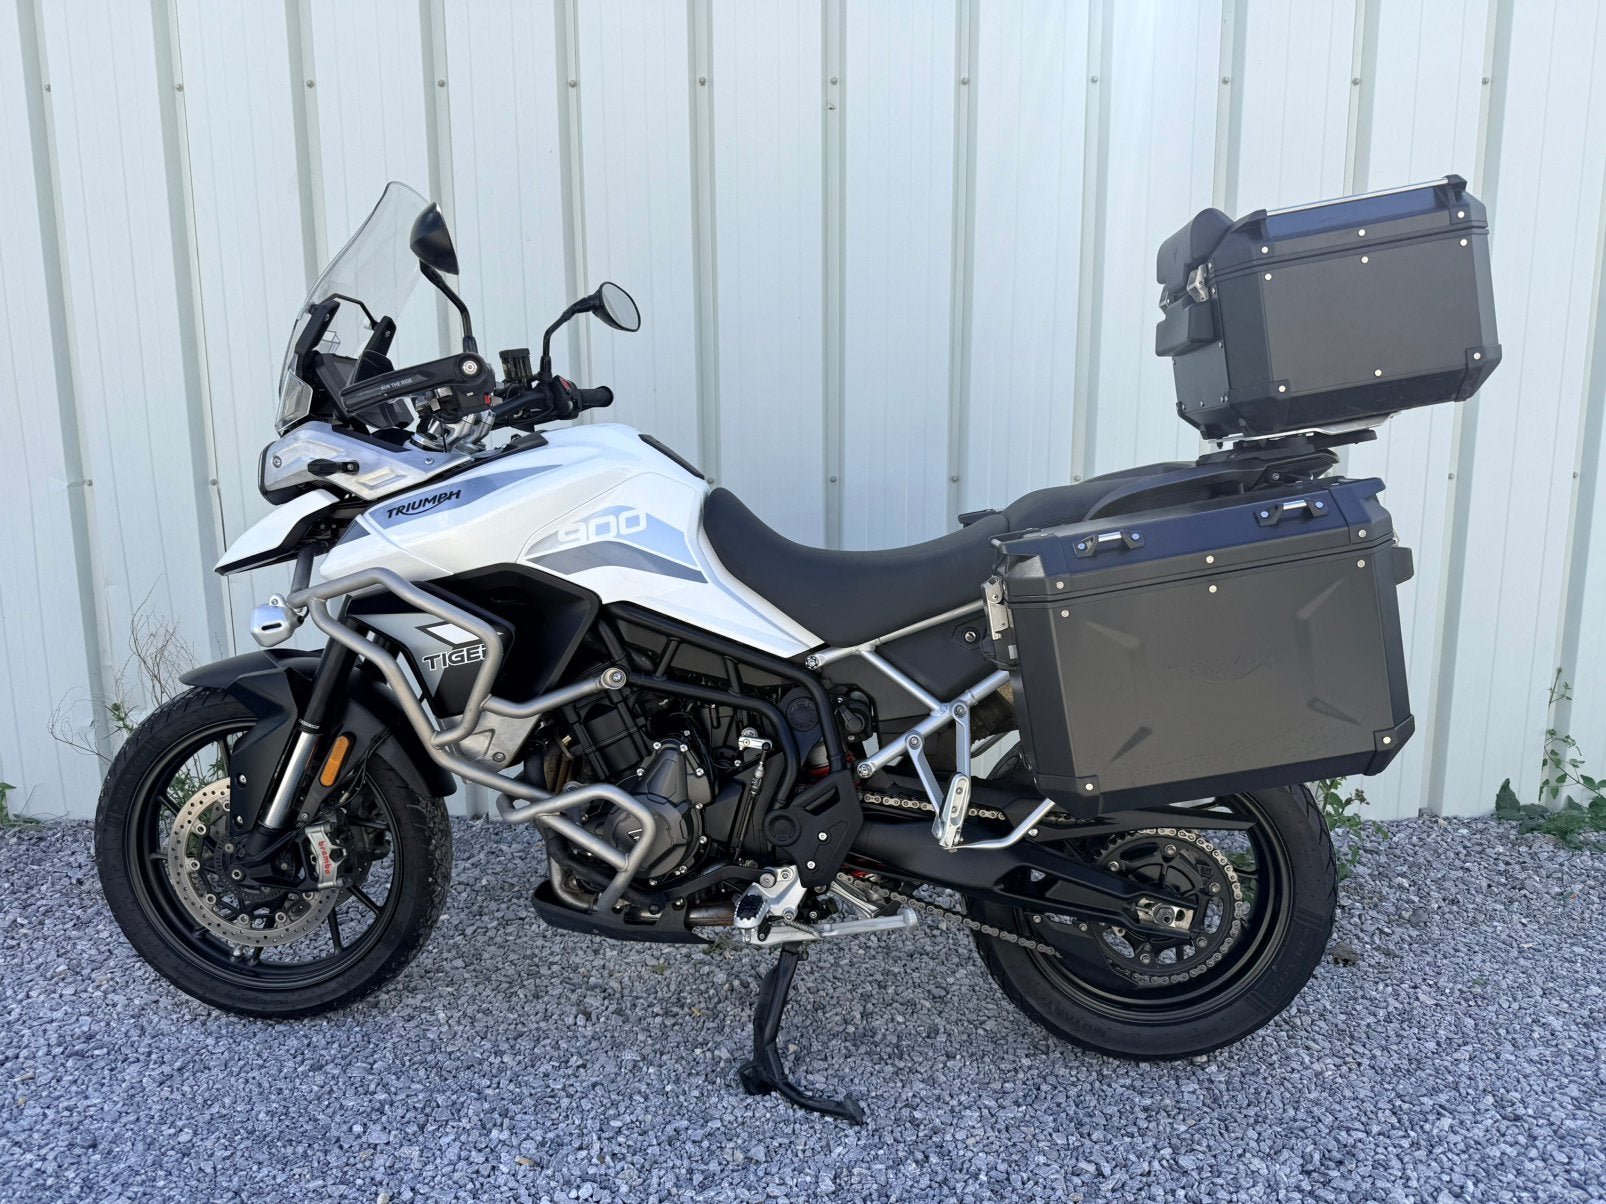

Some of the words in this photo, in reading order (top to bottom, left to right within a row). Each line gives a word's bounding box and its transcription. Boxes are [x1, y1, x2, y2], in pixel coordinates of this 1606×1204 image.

[380, 383, 391, 392] FOR
[391, 380, 401, 389] THE
[401, 377, 413, 386] RIDE
[387, 489, 462, 519] TRIUMPH
[557, 508, 648, 543] 900
